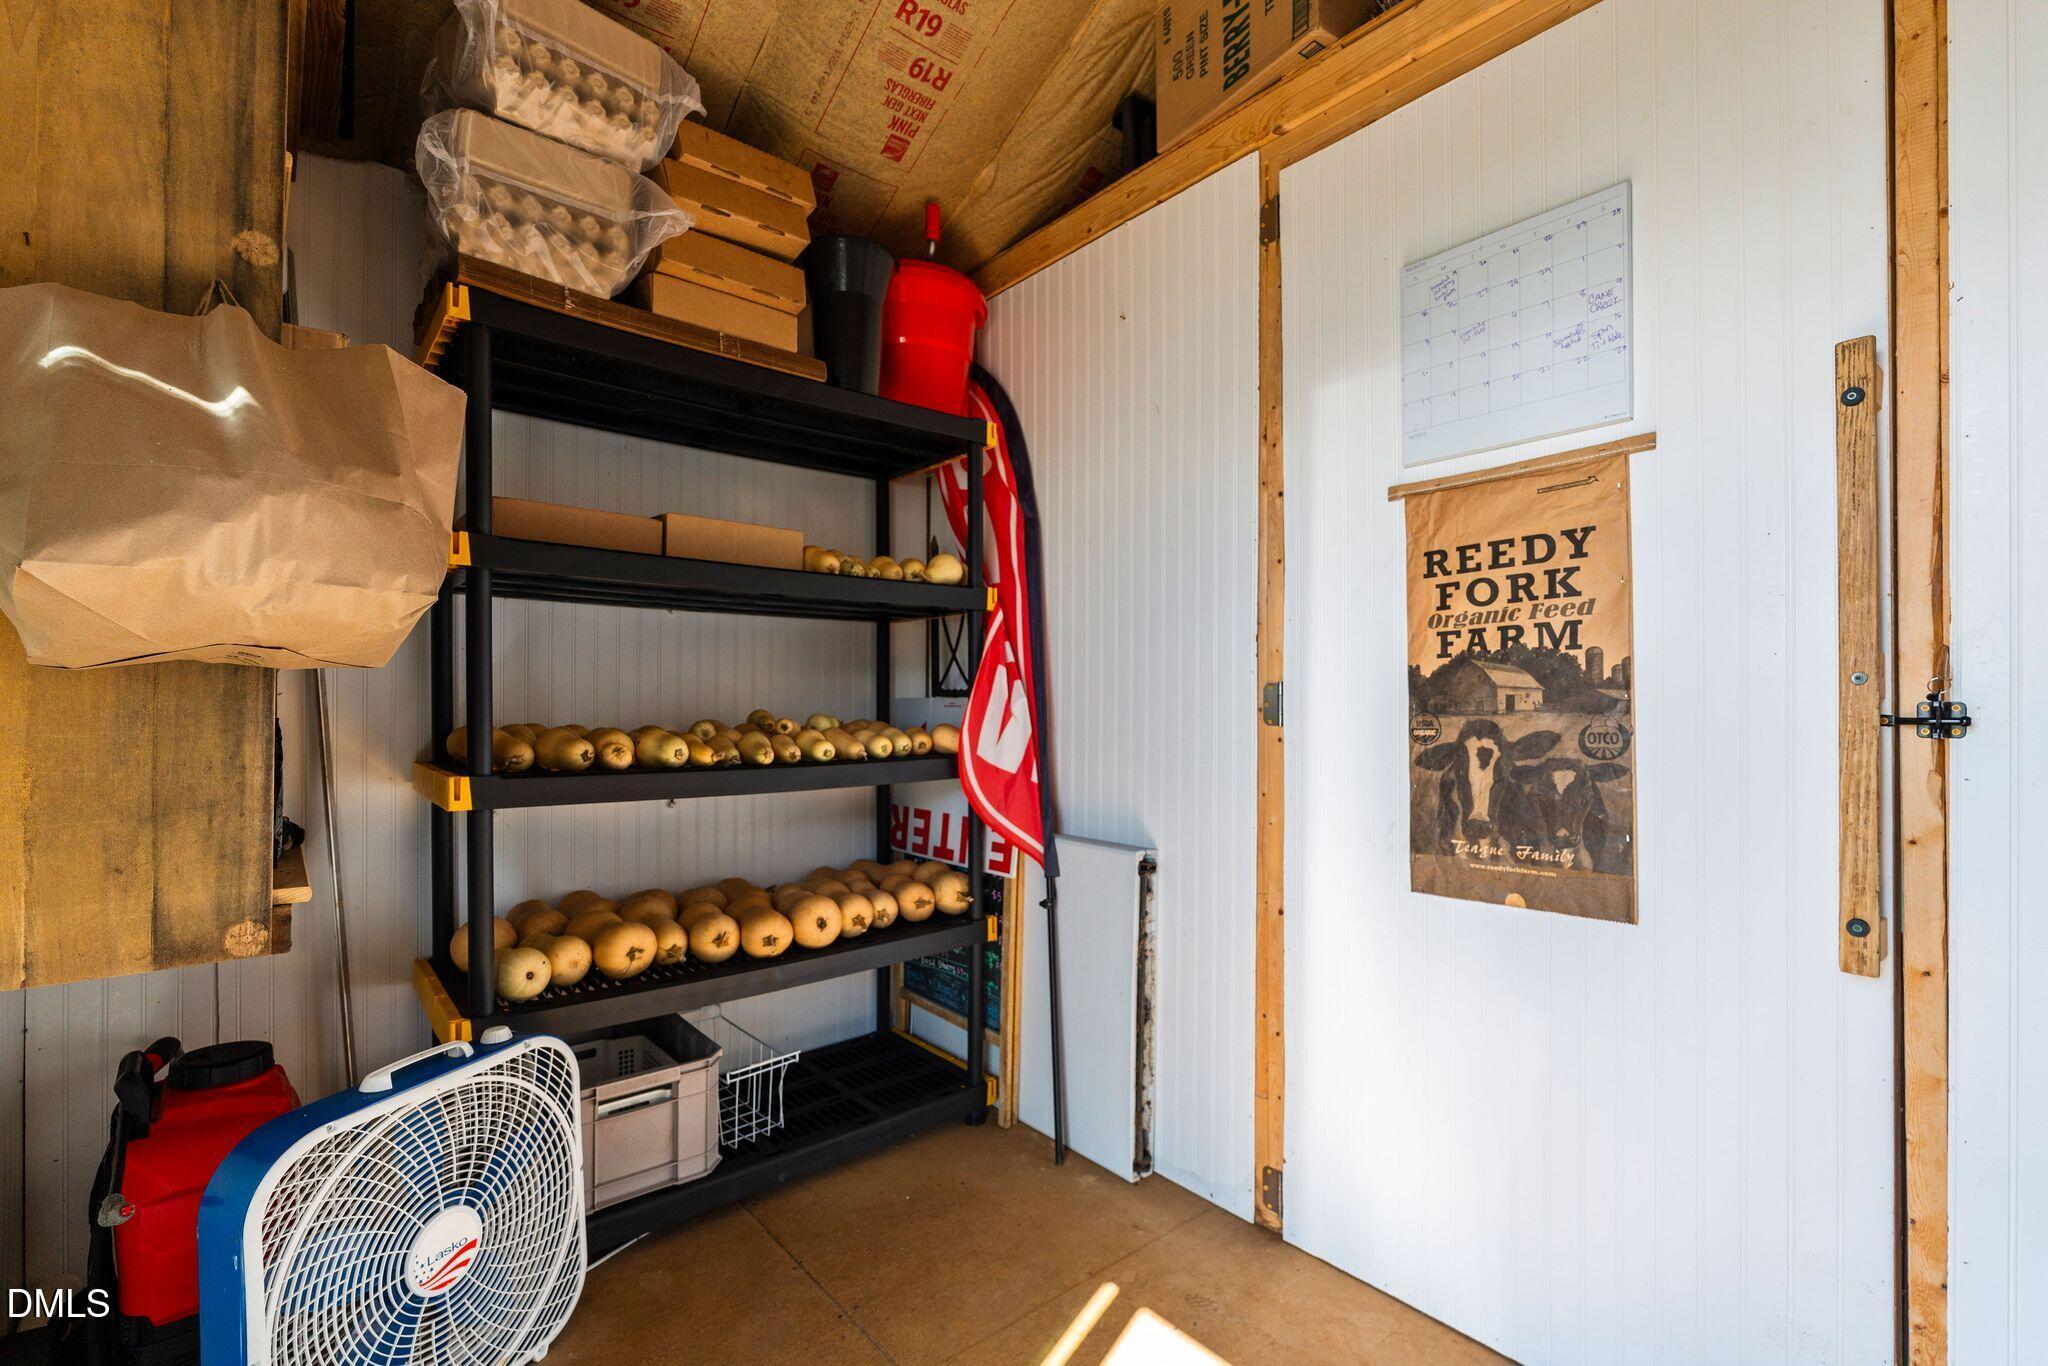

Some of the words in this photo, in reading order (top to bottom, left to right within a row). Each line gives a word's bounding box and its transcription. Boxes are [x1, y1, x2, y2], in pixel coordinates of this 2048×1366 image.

[1199, 10, 1209, 44] SIZE
[1185, 30, 1195, 80] GREEN
[1199, 45, 1209, 78] PINT
[1222, 0, 1250, 92] BERRY-
[908, 57, 953, 92] R19
[1173, 50, 1184, 81] 500
[887, 115, 921, 138] PINK
[903, 105, 928, 123] NEXT
[1423, 525, 1597, 579] REEDY
[1435, 566, 1582, 611] FORK
[1527, 598, 1597, 620] Feed
[1436, 619, 1583, 659] FARM
[1416, 720, 1434, 728] USDA
[1587, 732, 1620, 745] OTCO
[891, 804, 1014, 875] ETER
[1451, 839, 1504, 858] Teague
[1516, 846, 1575, 868] Family
[427, 1237, 467, 1266] Lasko
